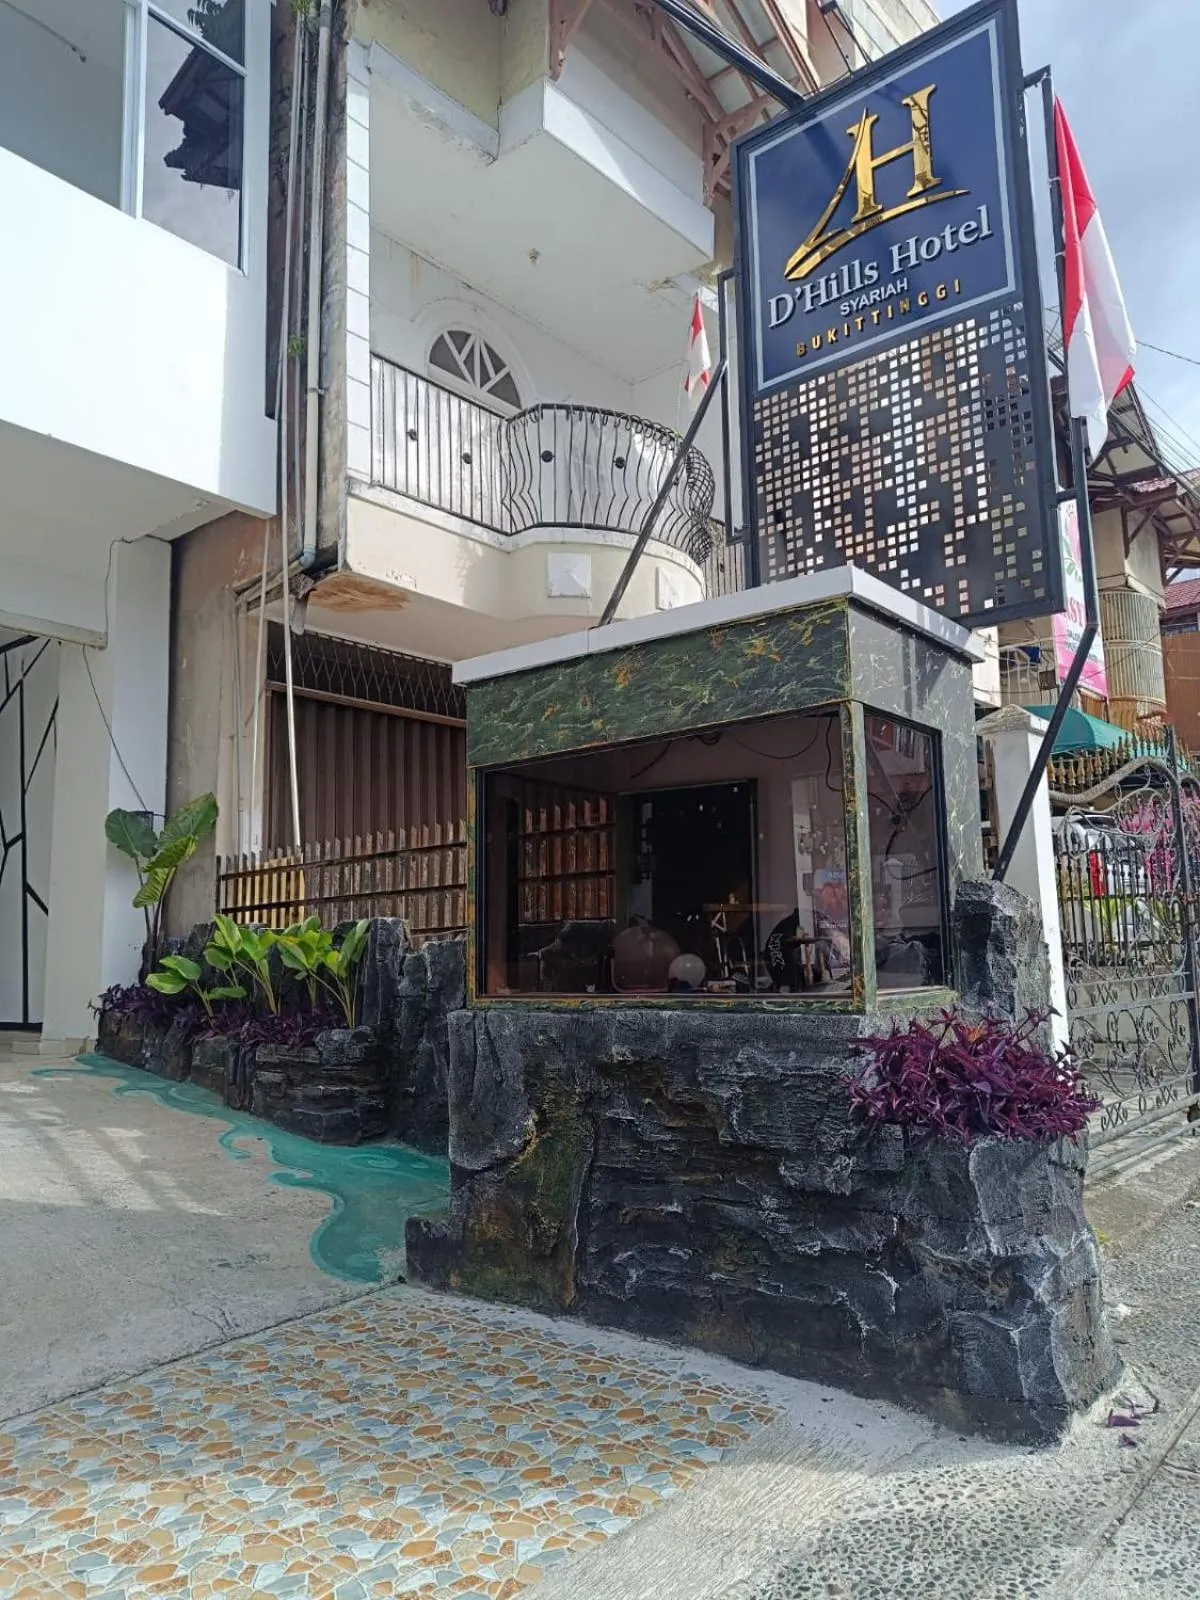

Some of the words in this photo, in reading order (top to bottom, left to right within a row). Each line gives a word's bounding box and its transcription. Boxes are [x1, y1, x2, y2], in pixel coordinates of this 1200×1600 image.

[768, 259, 879, 329] D'Hills
[889, 204, 993, 275] Hotel
[840, 277, 908, 316] SYARIAH
[796, 278, 961, 356] BUKITTINGGI
